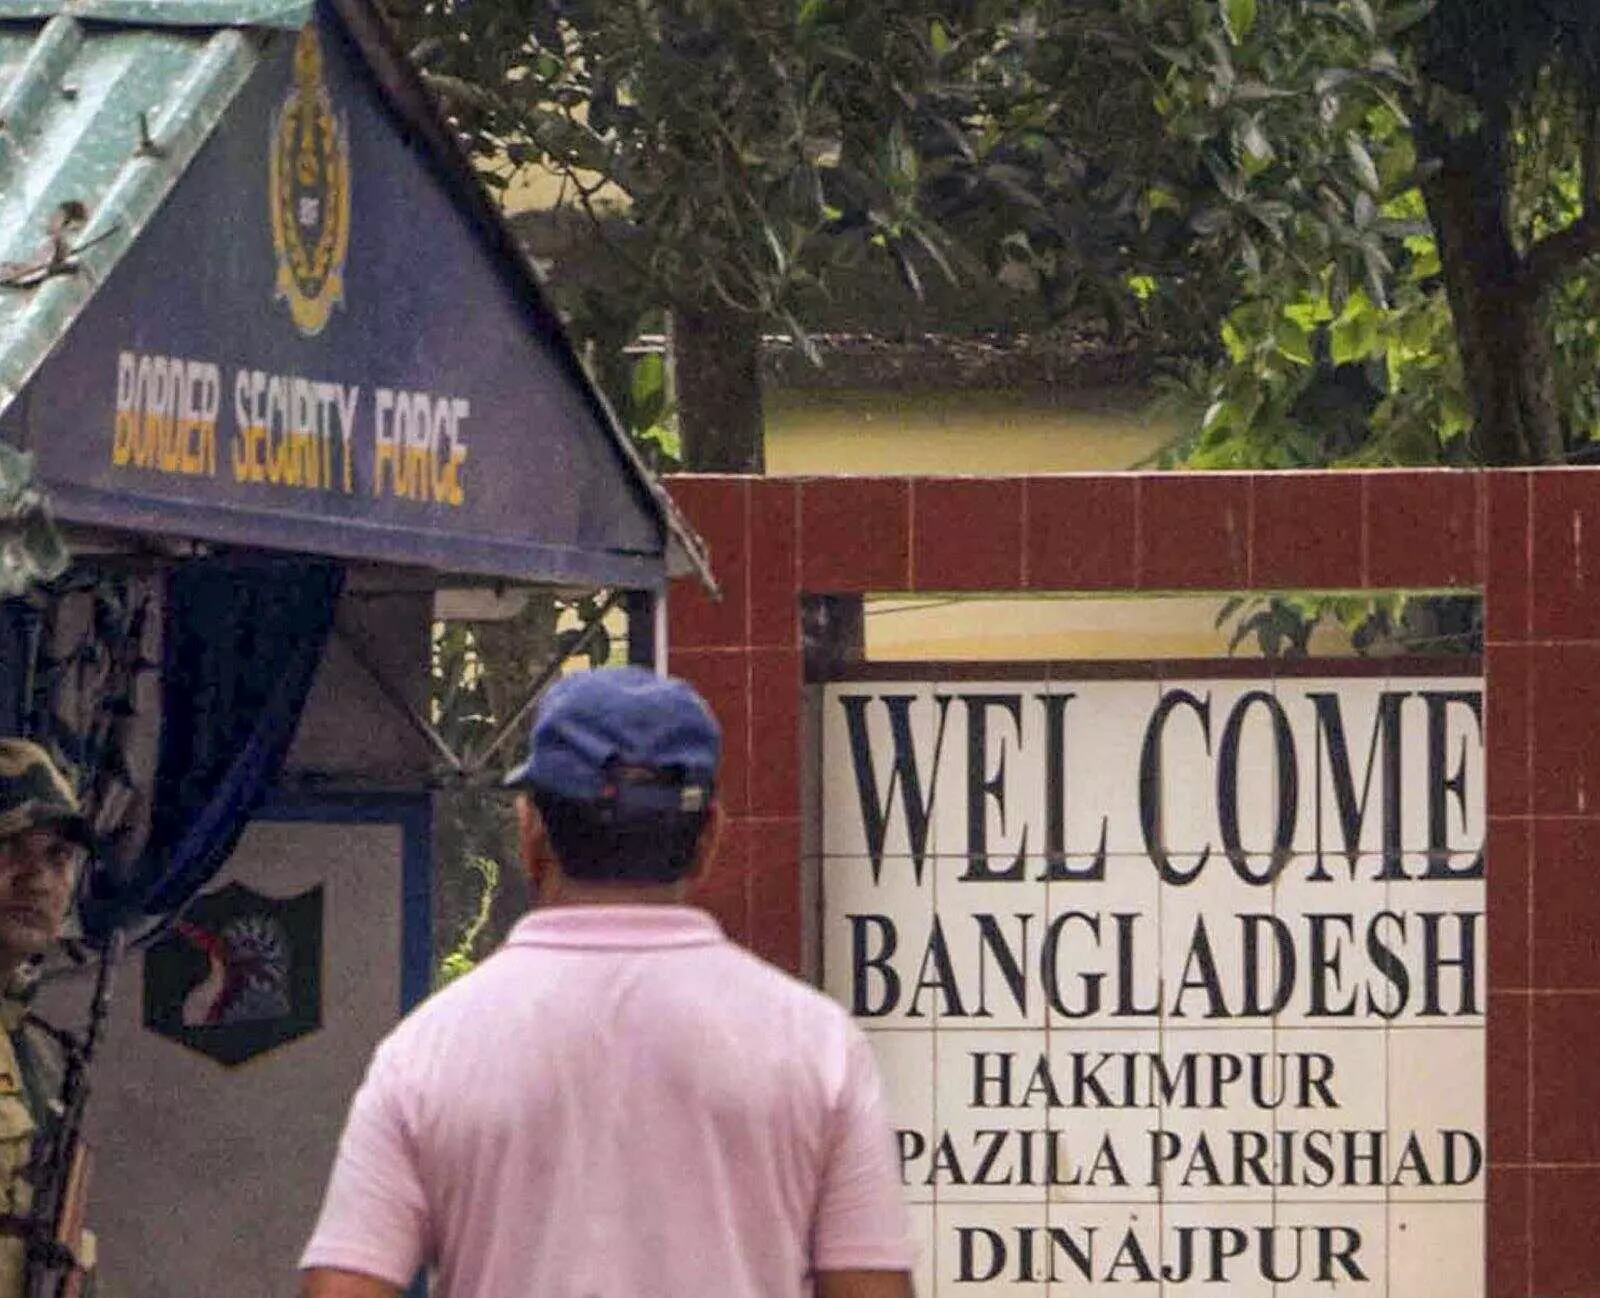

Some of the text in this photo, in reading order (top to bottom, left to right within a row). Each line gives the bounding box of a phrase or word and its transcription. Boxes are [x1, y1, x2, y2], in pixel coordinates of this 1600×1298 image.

[111, 351, 471, 507] BORDER SECURITY FORCE
[845, 909, 1485, 1020] BANGLADESH
[968, 1051, 1342, 1111] HAKIMPUR
[895, 1128, 1484, 1187] PAZILA PARISHAD
[952, 1225, 1371, 1284] DINAJPUR
